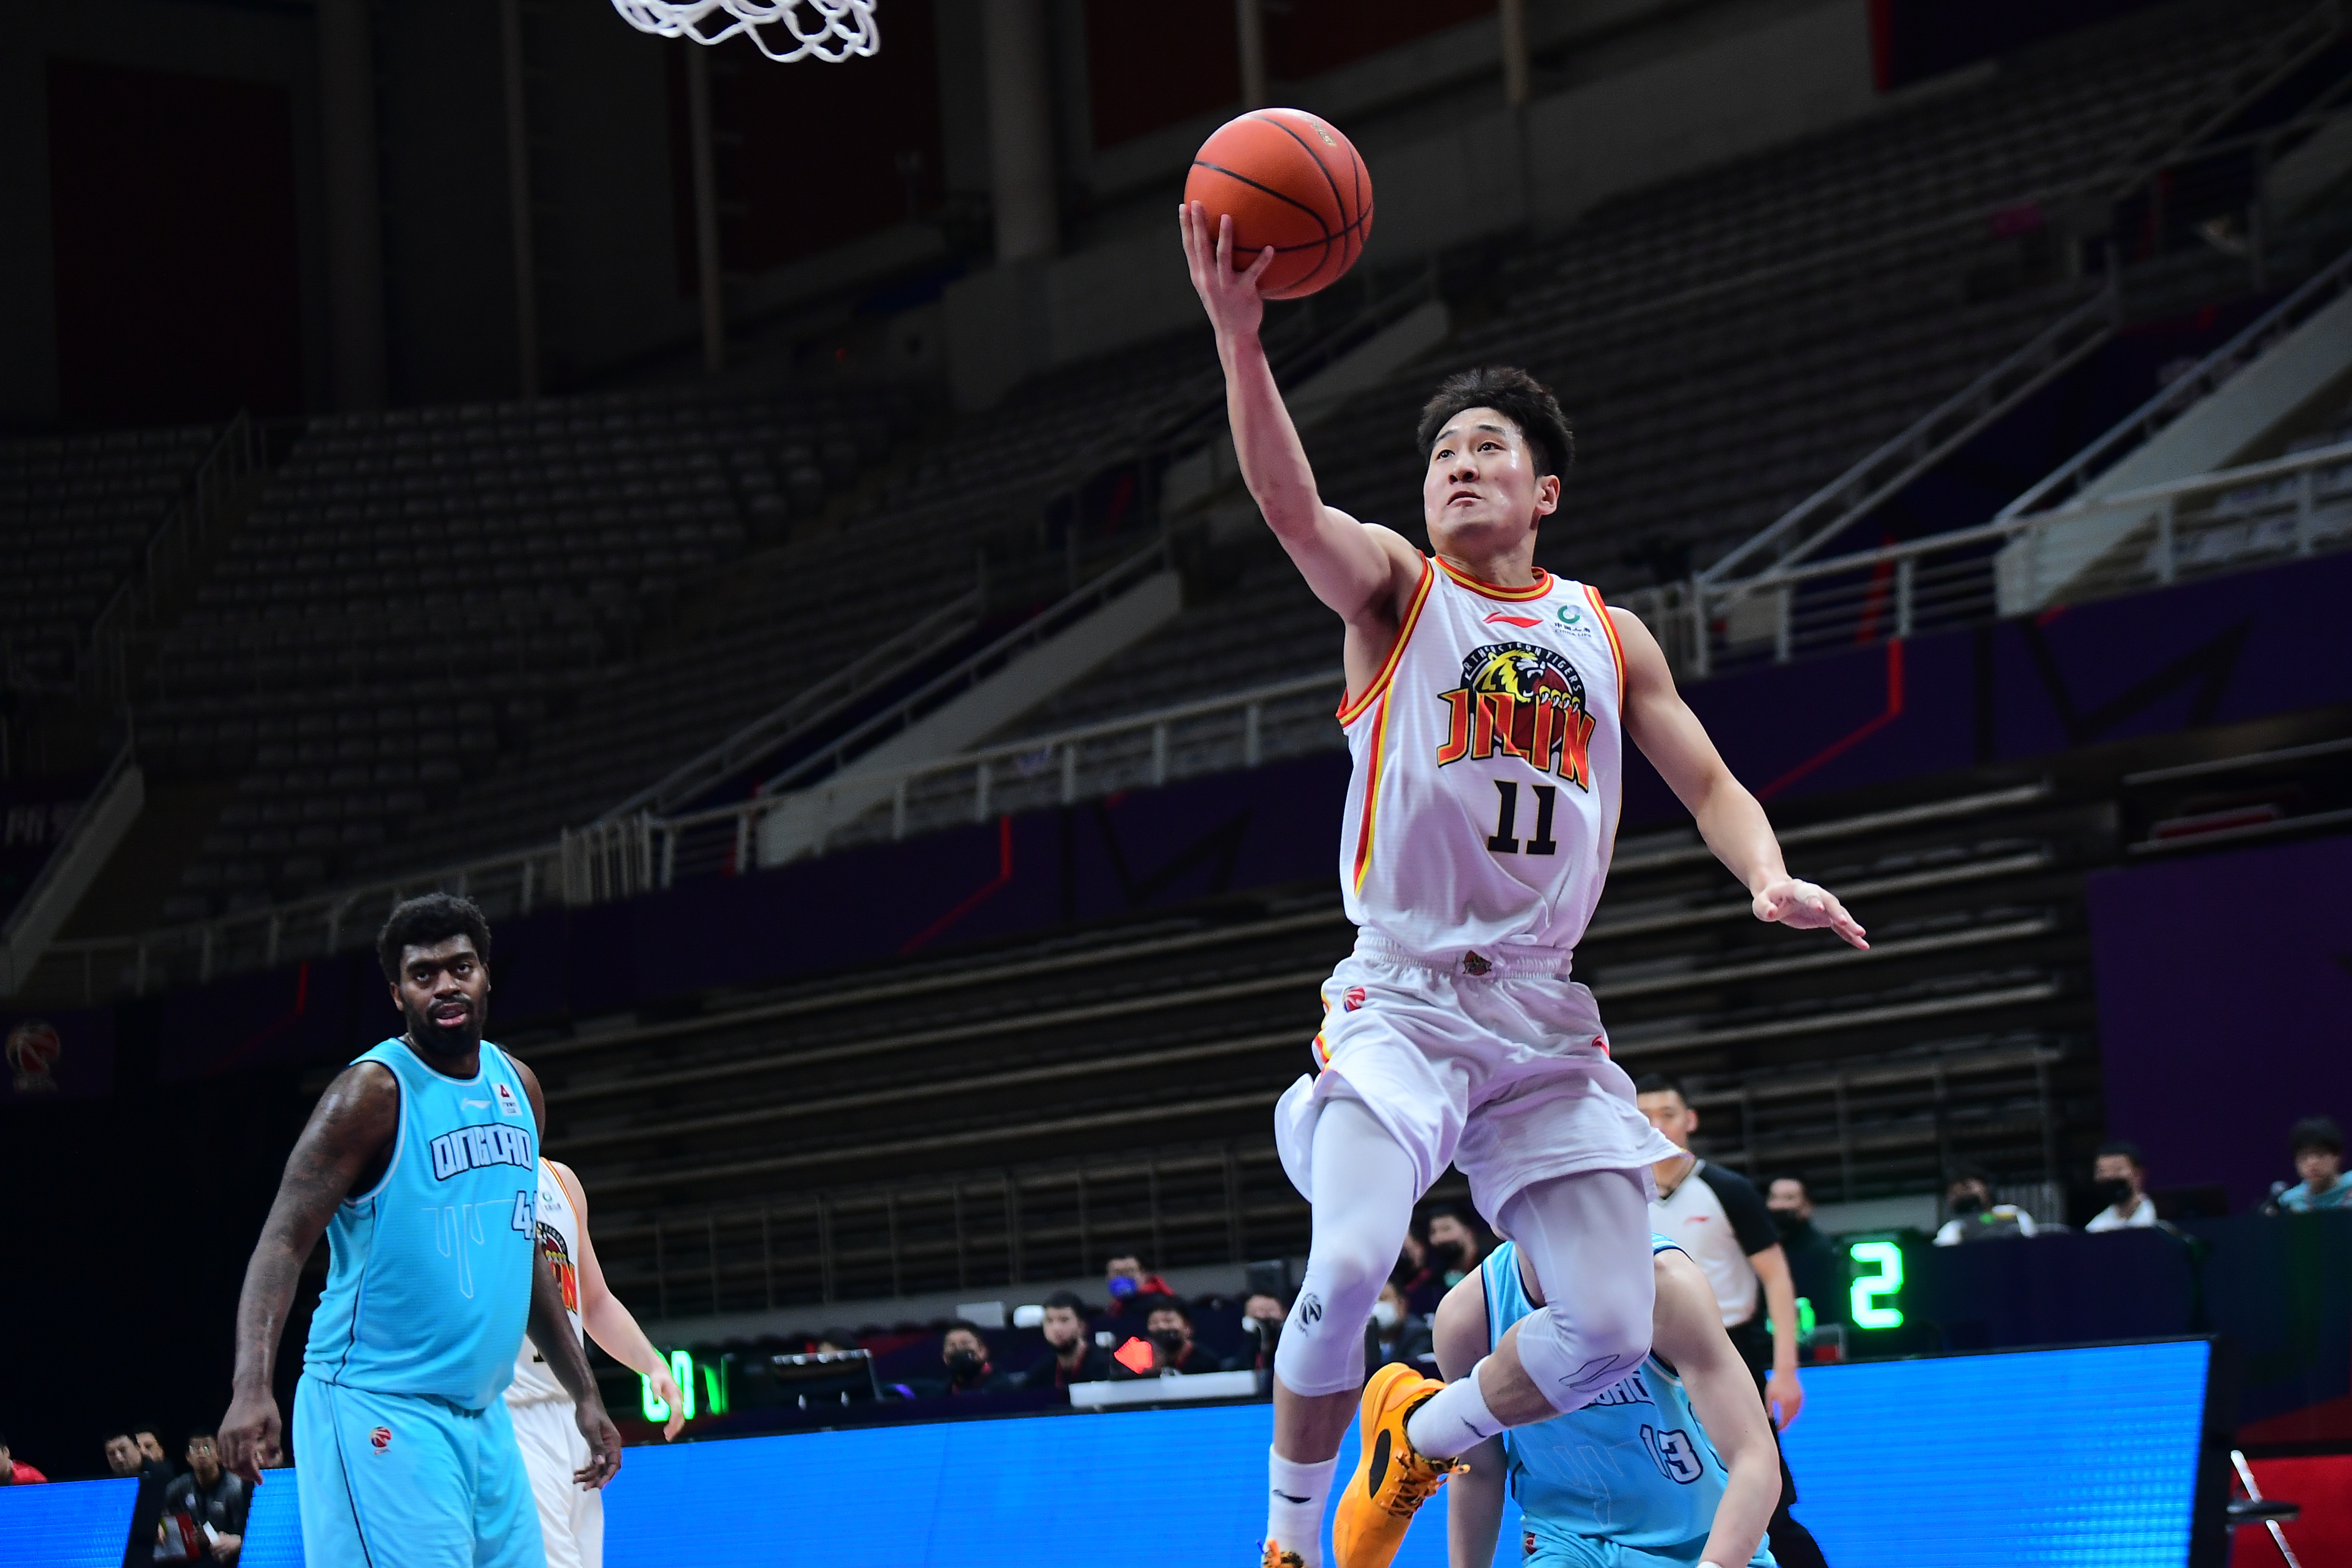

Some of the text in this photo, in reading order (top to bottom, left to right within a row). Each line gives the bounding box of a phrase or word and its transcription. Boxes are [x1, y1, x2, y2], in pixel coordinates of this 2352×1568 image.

[1545, 651, 1582, 692] TIGERS
[1437, 687, 1596, 793] JILIN
[1487, 779, 1557, 855] 11
[430, 1122, 533, 1182] QINGDAO
[1850, 1241, 1904, 1330] 2
[1639, 1423, 1704, 1485] 13
